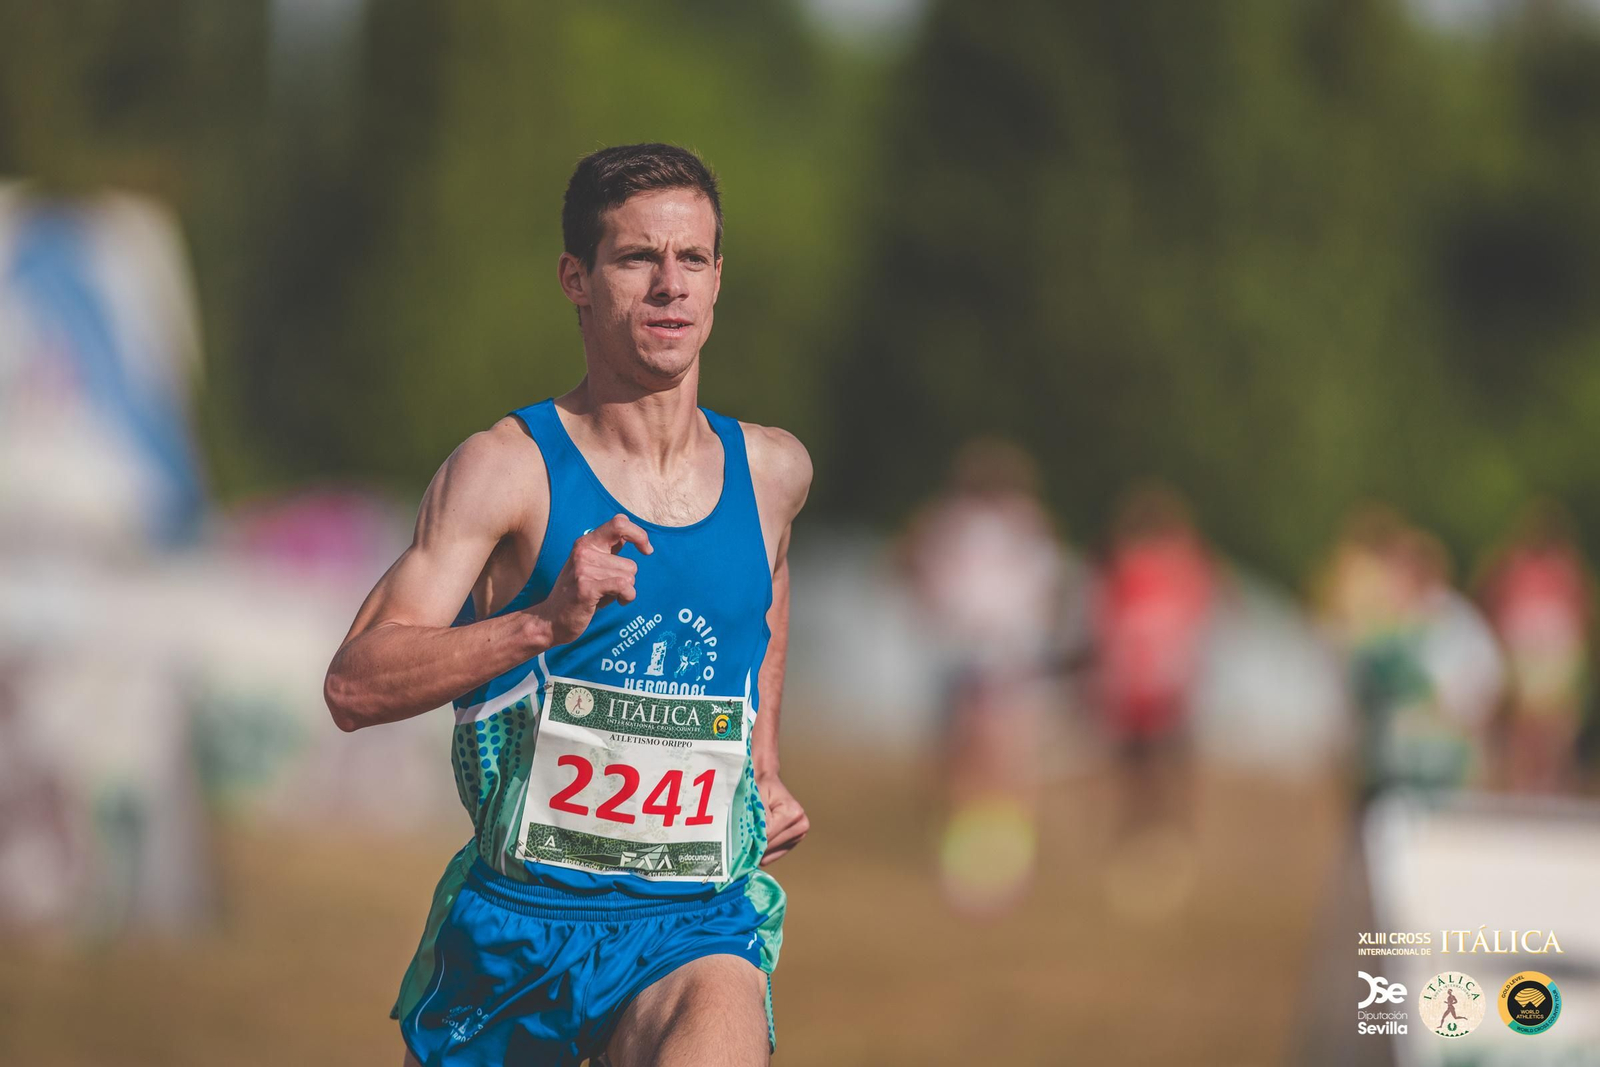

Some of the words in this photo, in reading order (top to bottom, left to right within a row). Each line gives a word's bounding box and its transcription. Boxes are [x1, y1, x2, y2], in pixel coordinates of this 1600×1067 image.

[611, 613, 663, 657] ATLETISMO
[619, 615, 646, 639] CLUB
[678, 608, 718, 681] ORIPPO
[601, 658, 636, 675] DOS
[623, 677, 706, 697] HERMANAS
[607, 698, 701, 726] ITÁLICA
[606, 718, 655, 731] INTERNATIONAL
[609, 734, 660, 746] ATLETISMO
[662, 739, 693, 748] ORIPPO
[549, 754, 717, 827] 2241
[679, 853, 715, 862] @docunova
